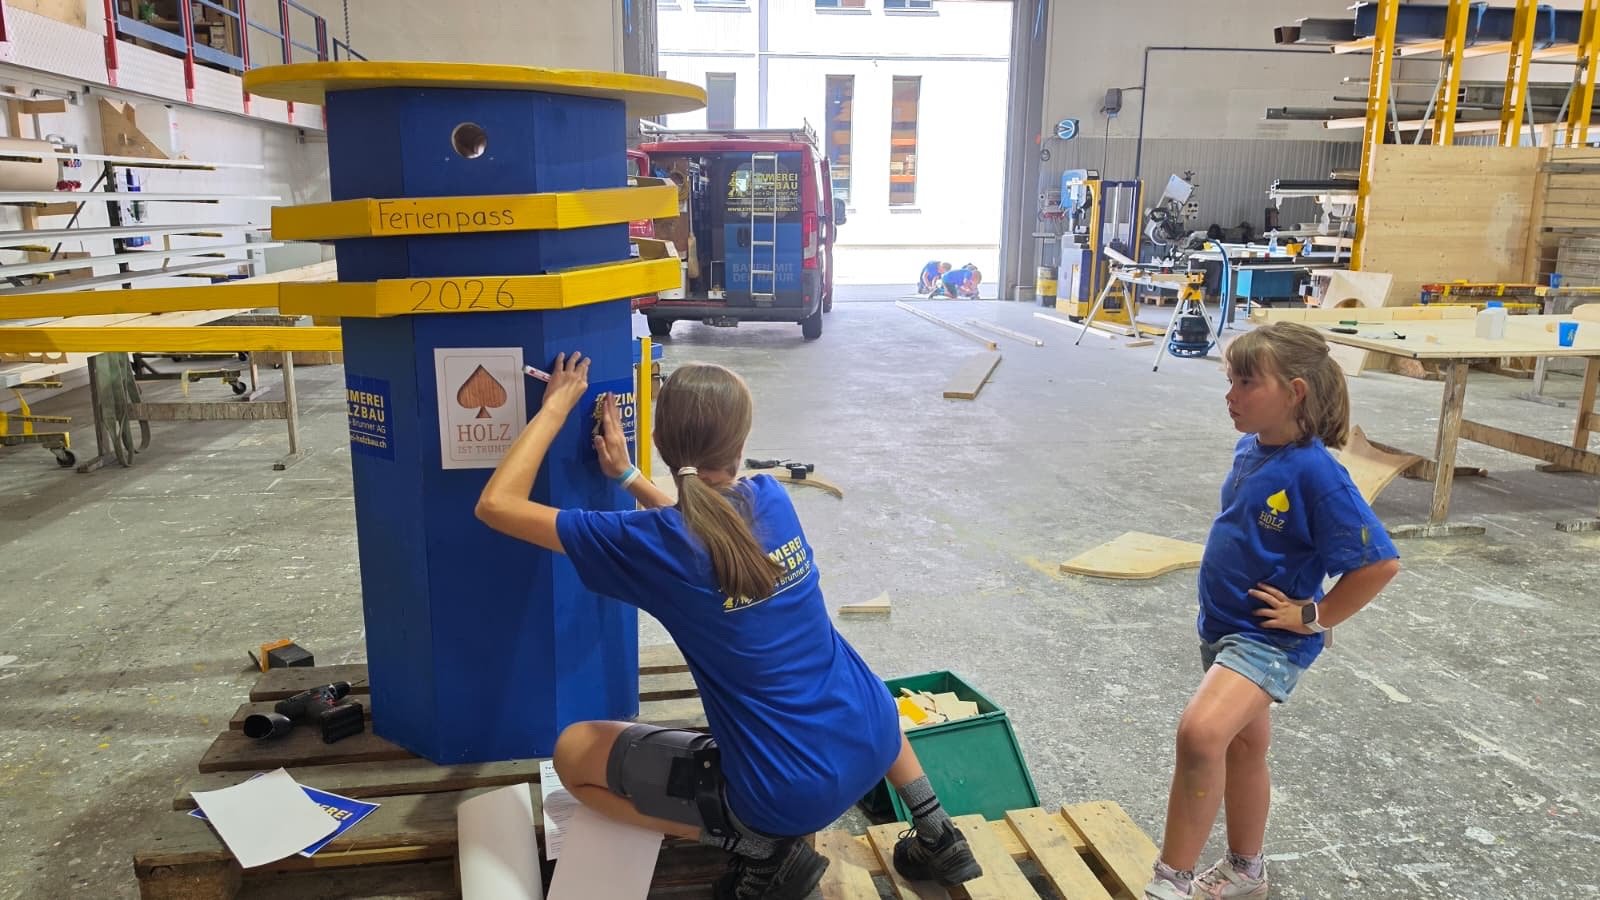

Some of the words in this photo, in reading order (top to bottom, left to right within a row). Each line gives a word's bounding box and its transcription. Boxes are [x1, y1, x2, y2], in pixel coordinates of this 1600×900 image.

[378, 201, 515, 232] Ferienpass
[410, 280, 514, 311] 2026
[376, 425, 386, 434] AG
[456, 423, 512, 442] HOLZ
[1259, 511, 1285, 528] HOLZ
